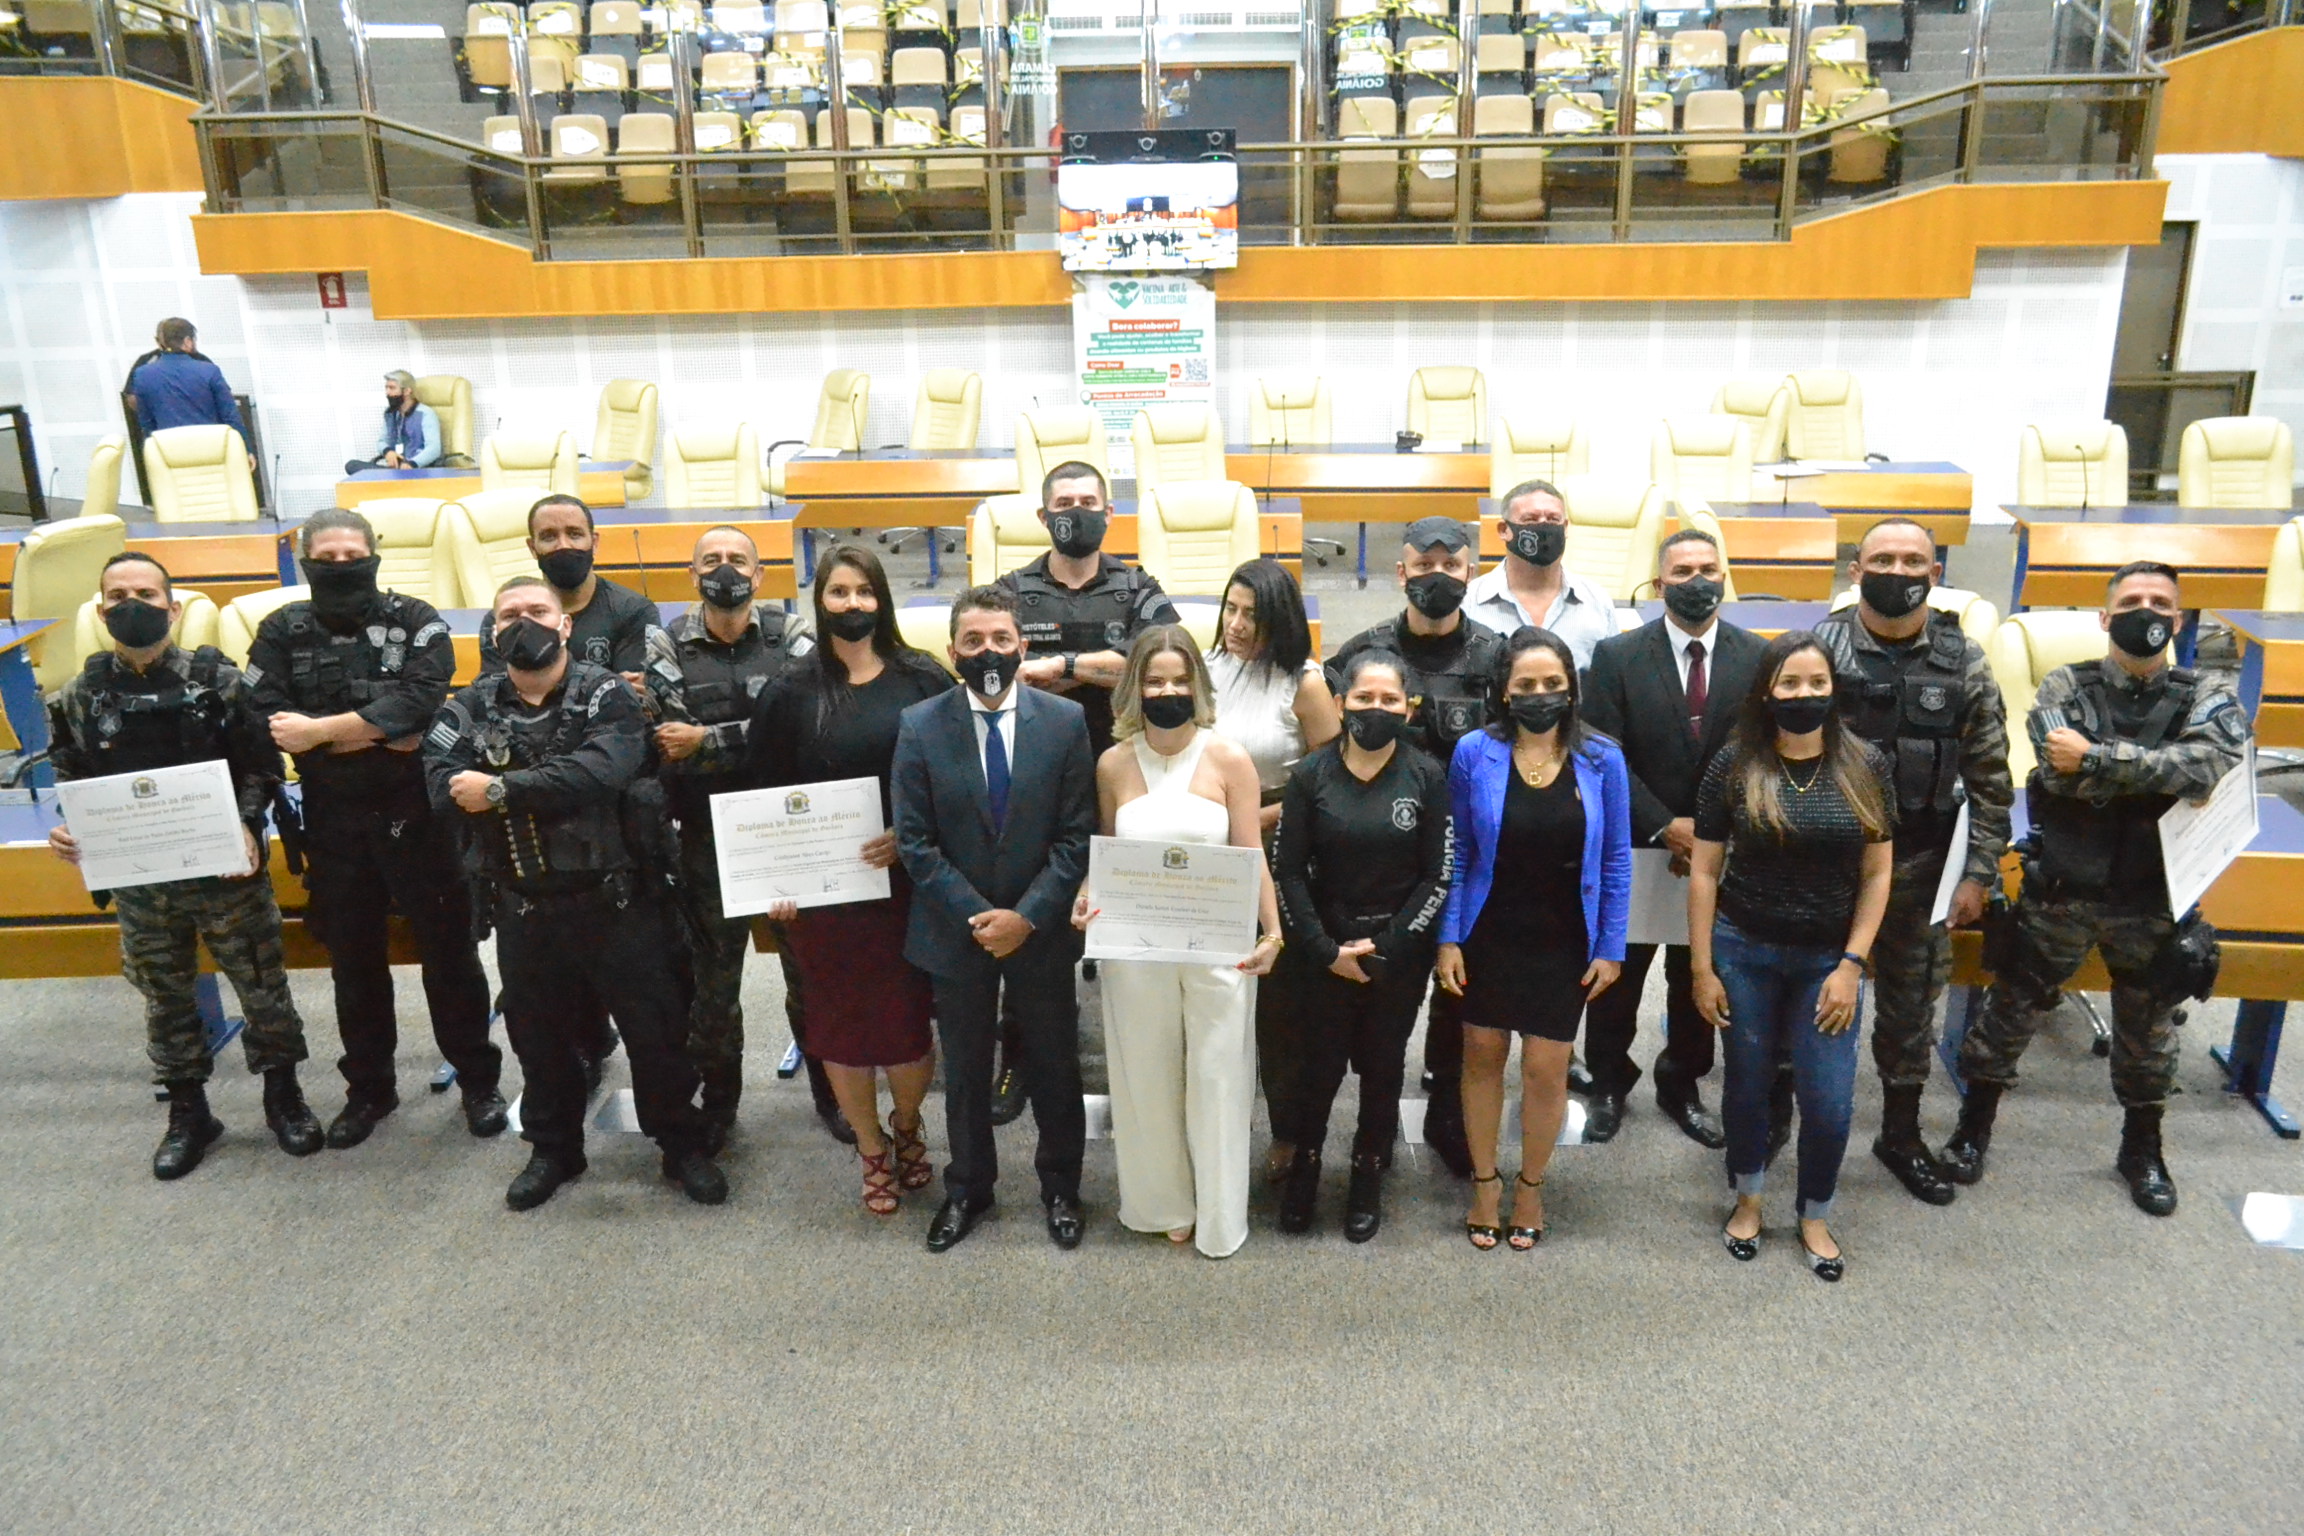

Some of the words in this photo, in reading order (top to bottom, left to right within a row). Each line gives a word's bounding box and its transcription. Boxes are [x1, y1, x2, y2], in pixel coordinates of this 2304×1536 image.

[1112, 322, 1132, 330] Bora
[1134, 322, 1178, 330] colaborar?
[736, 821, 773, 832] Diploma
[789, 816, 816, 826] Honra
[831, 810, 860, 822] Mérito
[1408, 886, 1448, 932] PENAL
